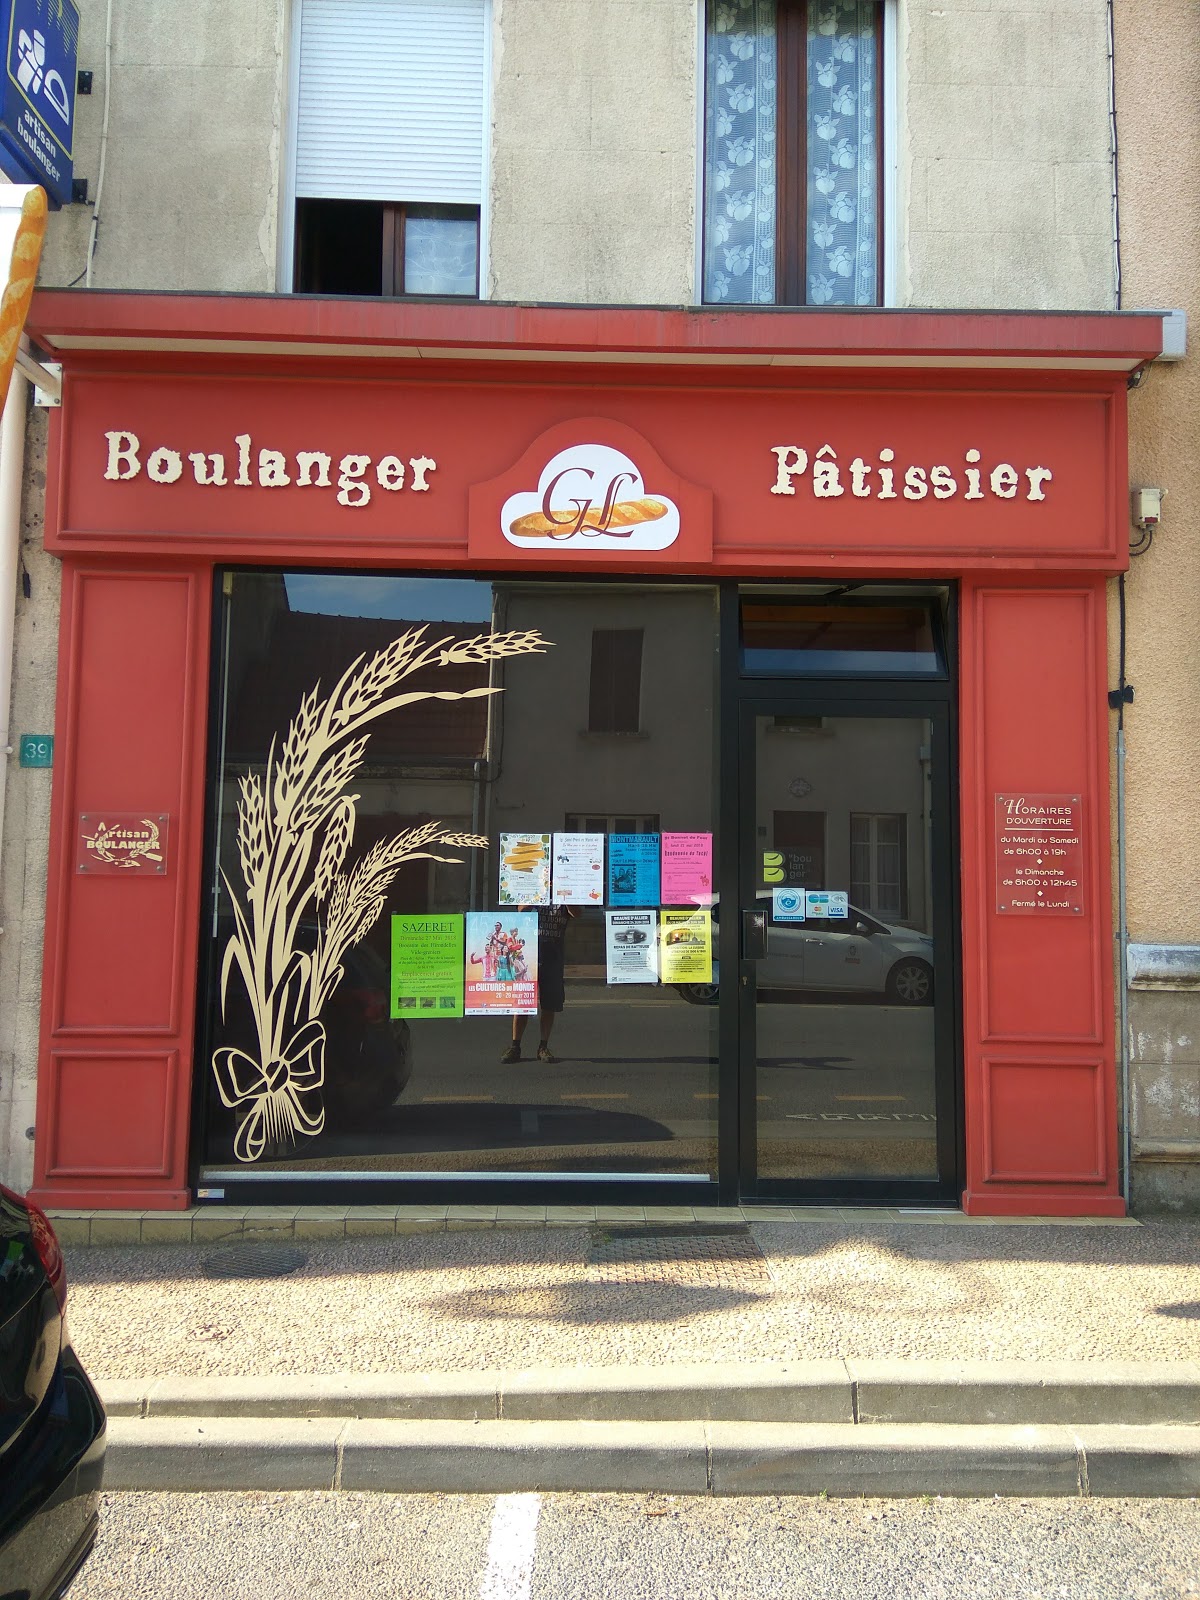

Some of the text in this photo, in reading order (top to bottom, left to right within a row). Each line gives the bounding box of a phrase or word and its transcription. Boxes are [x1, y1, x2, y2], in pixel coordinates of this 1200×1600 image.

[24, 109, 57, 159] artisan
[17, 116, 61, 183] boulanger
[104, 431, 437, 508] Boulanger
[770, 444, 1053, 501] Pâtissier
[542, 467, 639, 541] GL
[25, 743, 48, 758] 39
[1003, 797, 1072, 815] HORAIRES
[1006, 817, 1072, 826] D'OUVERTURE
[97, 821, 149, 839] Artisan
[86, 840, 161, 850] BOULANGER
[1012, 836, 1036, 844] Mardi
[1049, 836, 1079, 844] Samedi
[1003, 847, 1015, 855] de
[1043, 848, 1050, 856] à
[1051, 848, 1067, 856] 19h
[1024, 868, 1065, 876] Dimanche
[1002, 878, 1013, 886] de
[1050, 879, 1078, 887] 12h45
[1011, 899, 1036, 907] Fermé
[402, 922, 455, 932] SAZERET
[475, 983, 506, 991] CULTURES
[513, 983, 535, 991] MONDE
